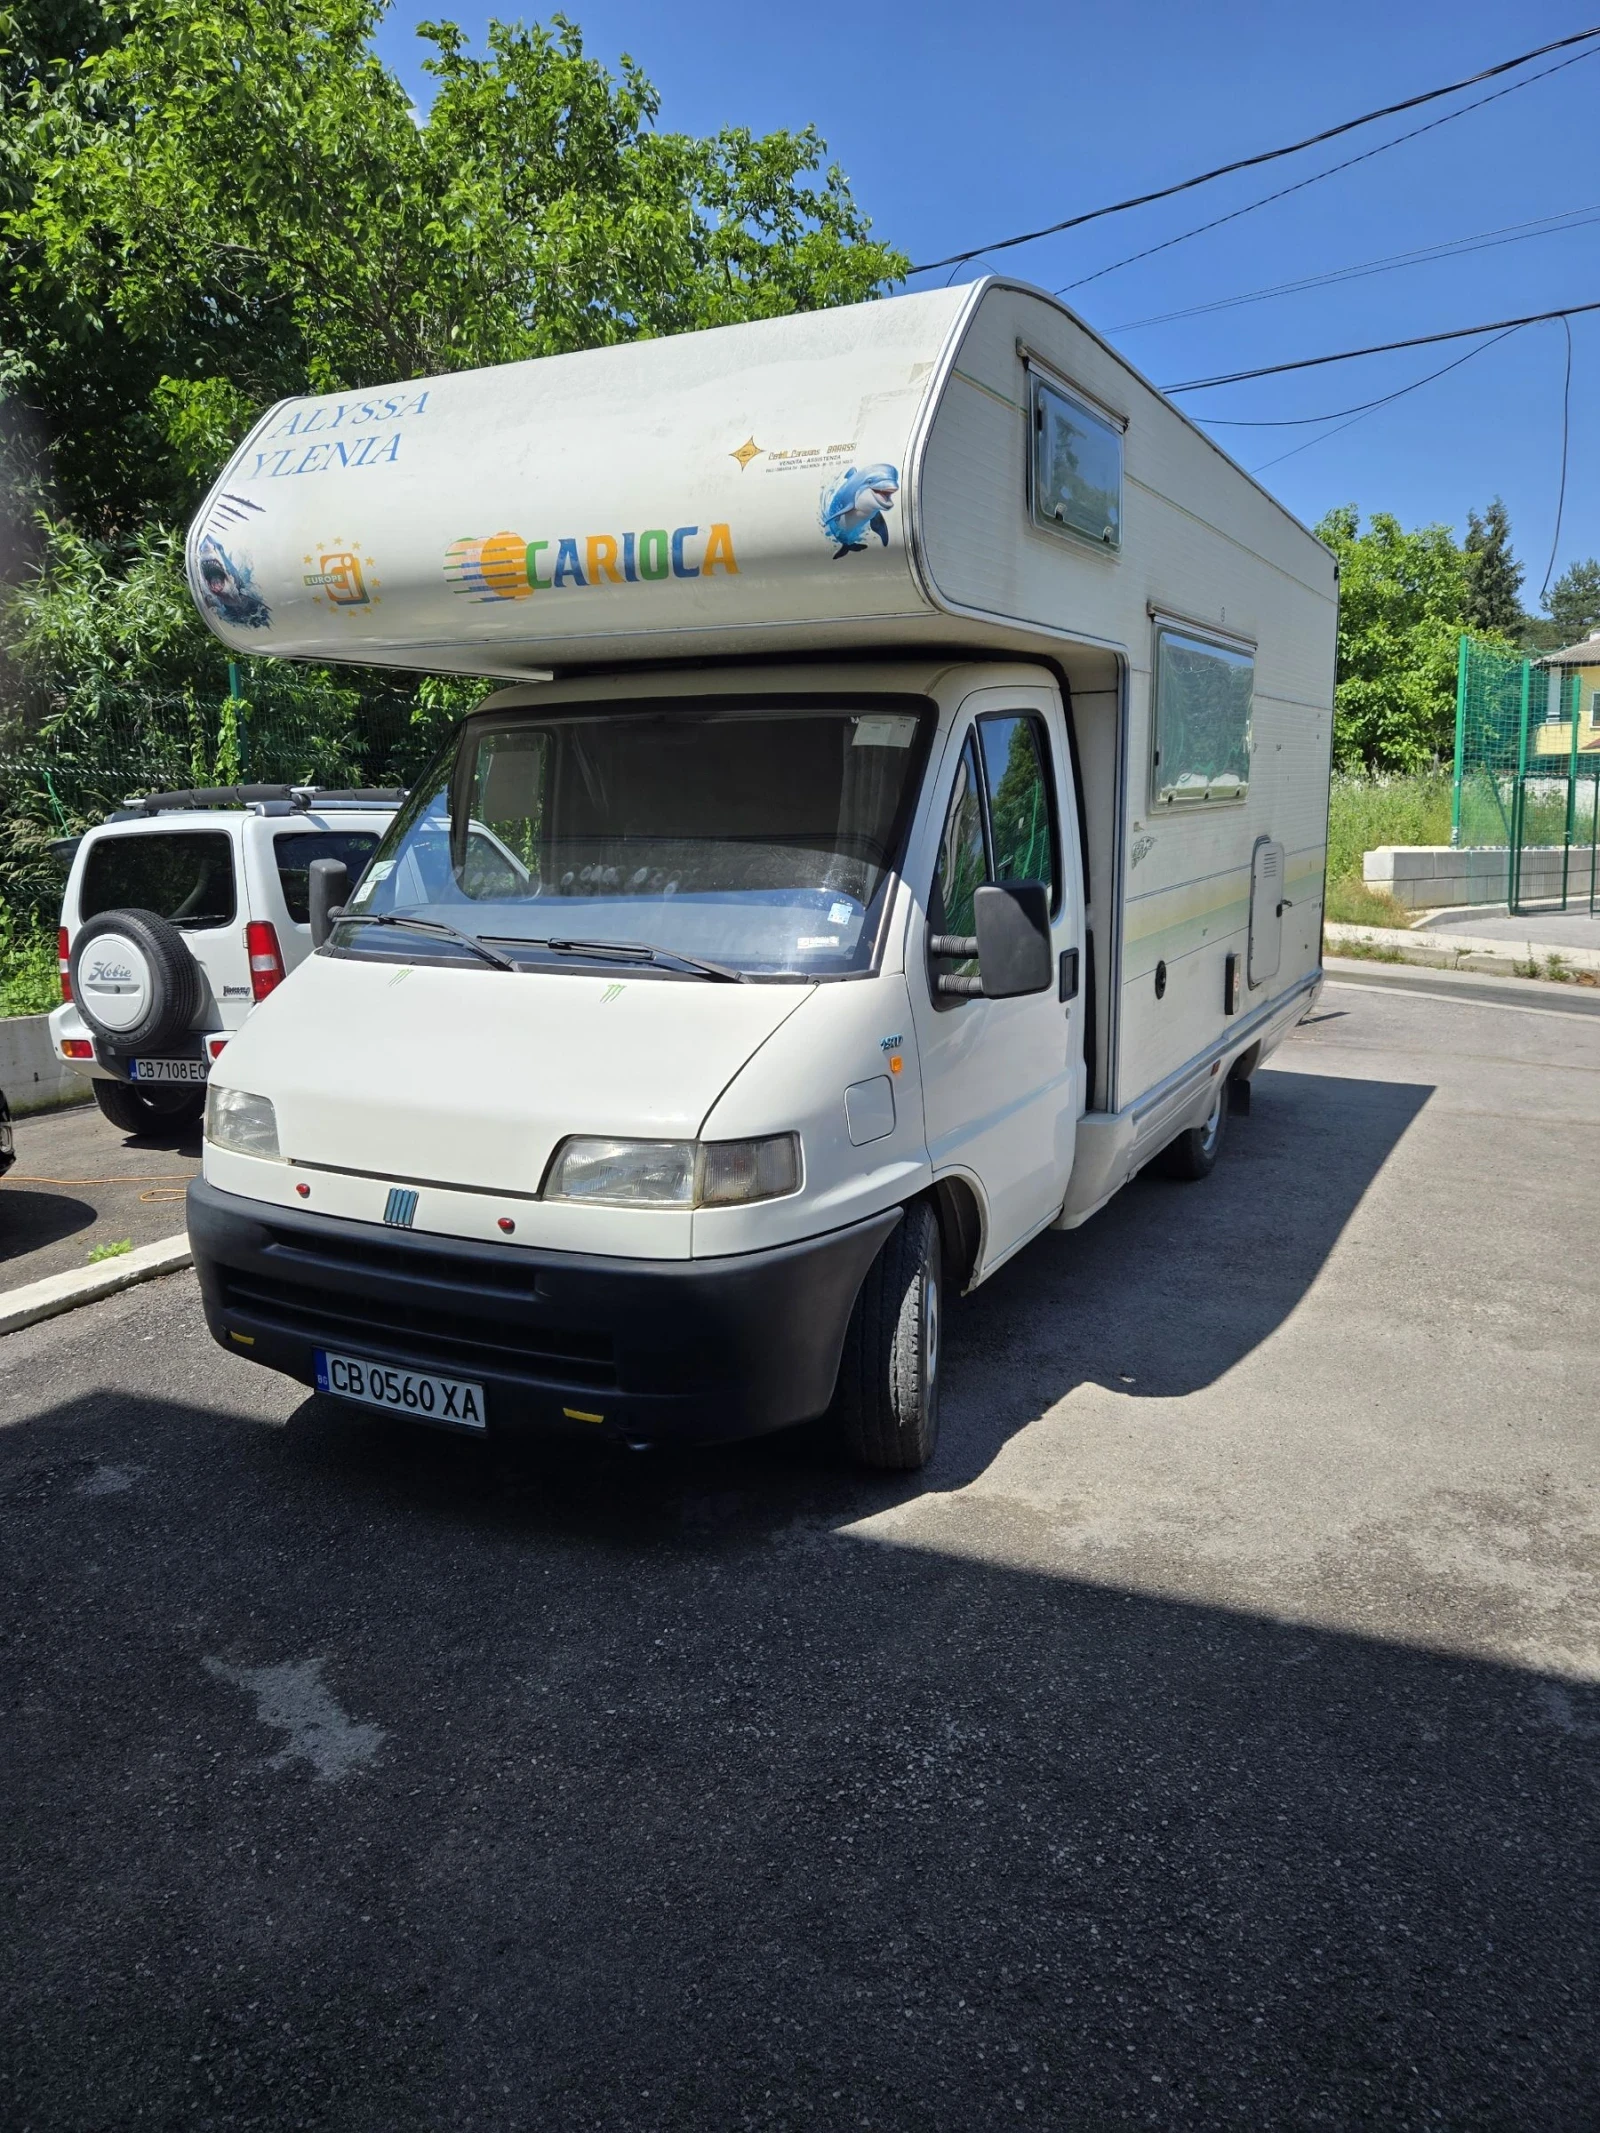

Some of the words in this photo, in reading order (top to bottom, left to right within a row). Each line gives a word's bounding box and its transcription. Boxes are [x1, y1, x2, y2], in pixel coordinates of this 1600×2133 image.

[267, 390, 431, 439] ALYSSA
[247, 433, 403, 481] YLENIA
[306, 574, 343, 586] EUROPE
[526, 523, 743, 590] CARIOCA
[88, 961, 132, 981] Hobie
[138, 1061, 155, 1078] CB
[156, 1062, 188, 1079] 7108
[331, 1359, 365, 1395] CB
[370, 1368, 435, 1412] 0560
[440, 1381, 480, 1422] XA
